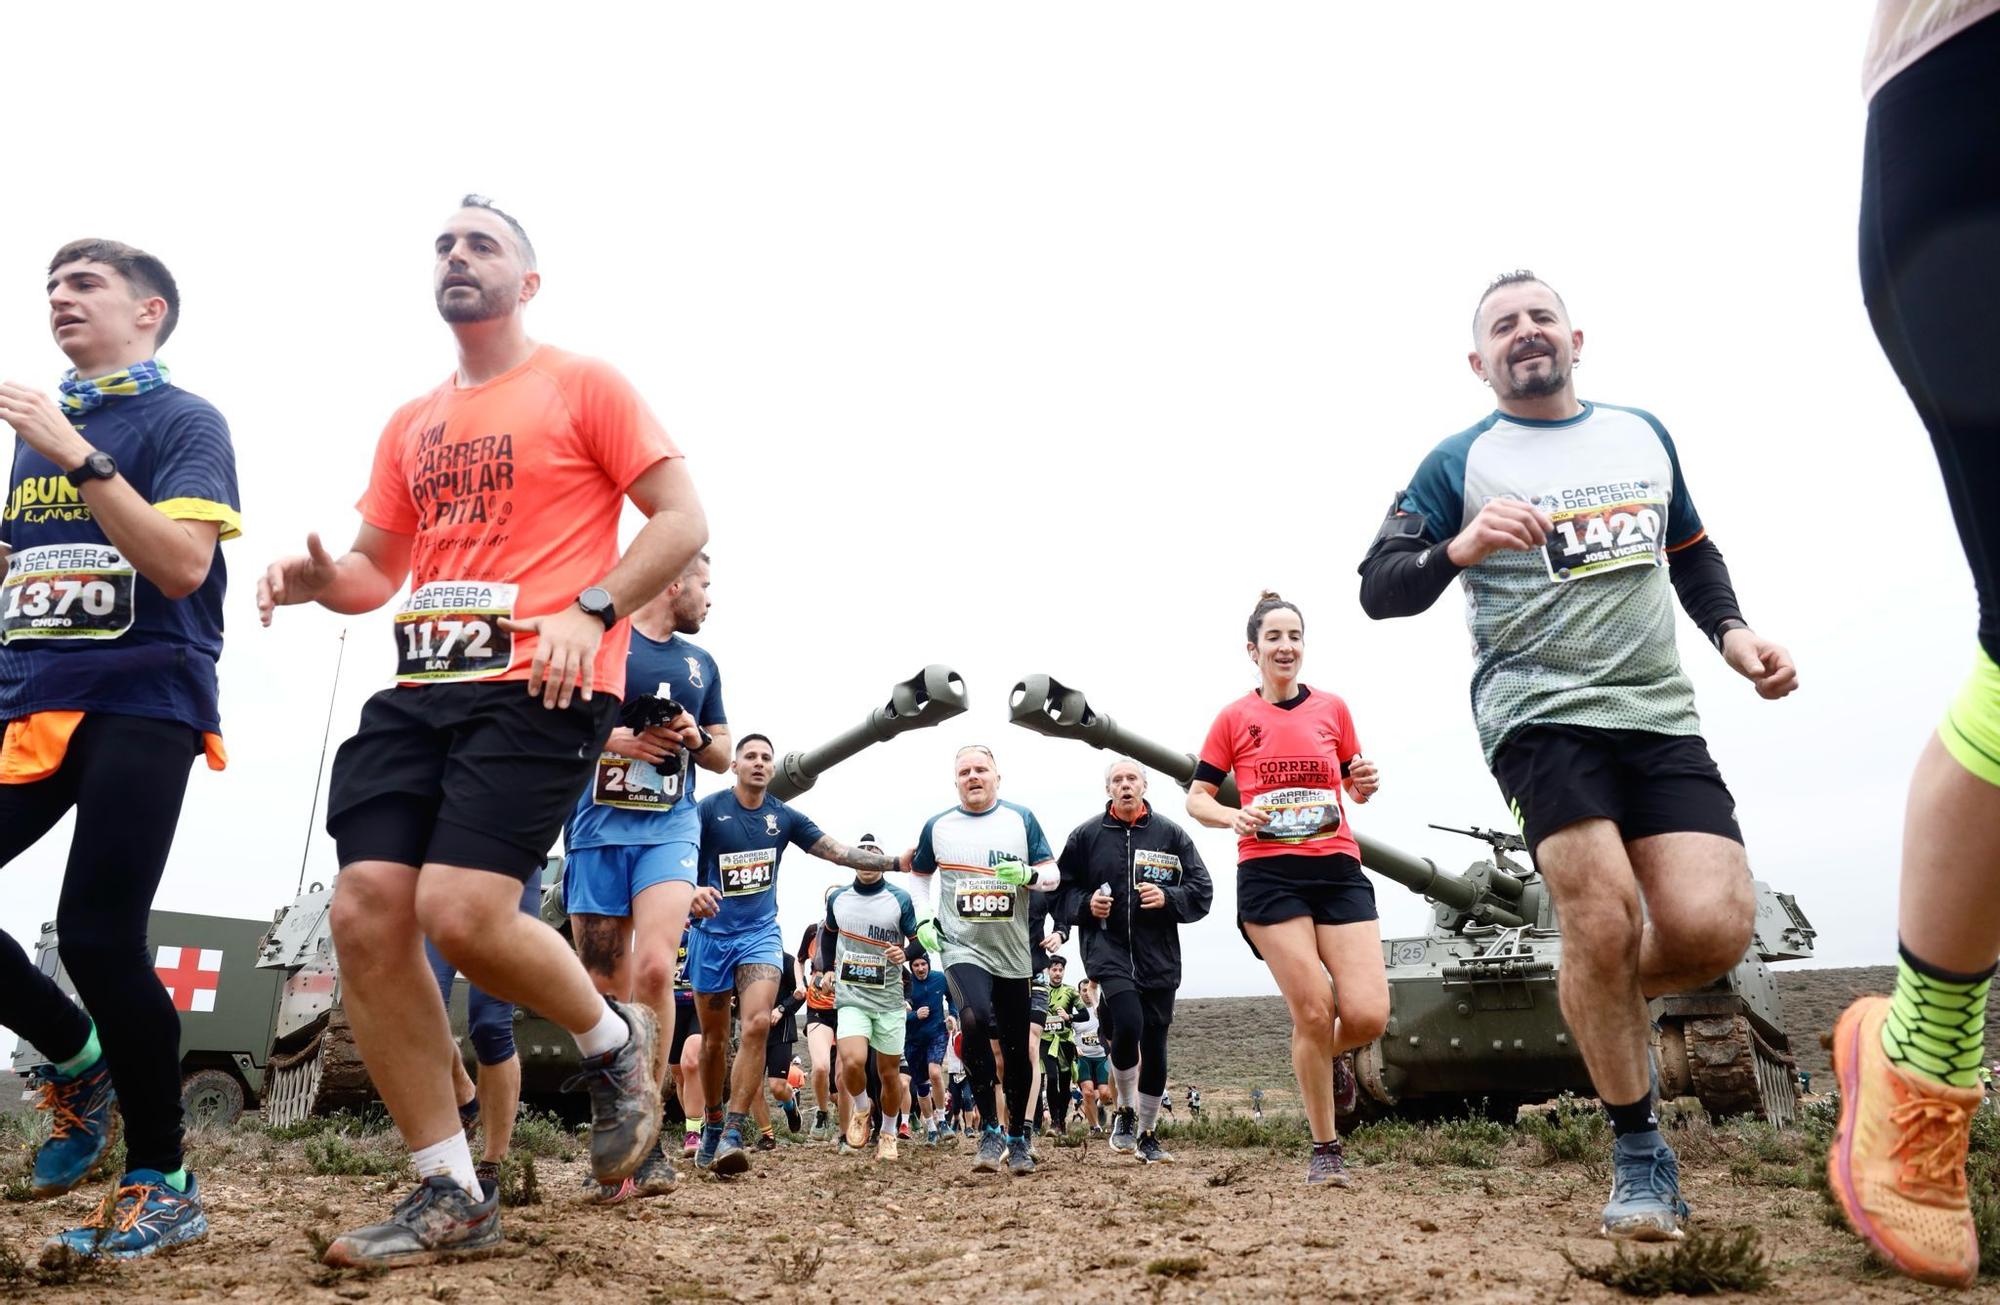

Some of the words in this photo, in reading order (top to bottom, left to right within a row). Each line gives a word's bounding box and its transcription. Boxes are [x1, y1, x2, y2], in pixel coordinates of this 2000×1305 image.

[413, 434, 514, 483] CARRERA
[412, 462, 515, 513] POPULAR
[1561, 480, 1646, 500] CARRERA
[4, 475, 80, 521] UBUN
[1556, 508, 1660, 557] 1420
[25, 548, 111, 562] CARRERA
[1582, 550, 1612, 564] JOSE
[4, 580, 116, 620] 1370
[416, 586, 492, 600] CARRERA
[31, 617, 73, 627] CHUFO
[403, 620, 493, 660] 1172
[1259, 760, 1319, 774] CORRER
[1260, 772, 1329, 785] VALIENTES
[628, 794, 658, 802] CARLOS
[1271, 790, 1323, 799] CARRERA
[733, 851, 769, 860] CARRERA
[727, 865, 770, 886] 2941
[962, 895, 1010, 912] 1969
[1403, 947, 1421, 960] 25
